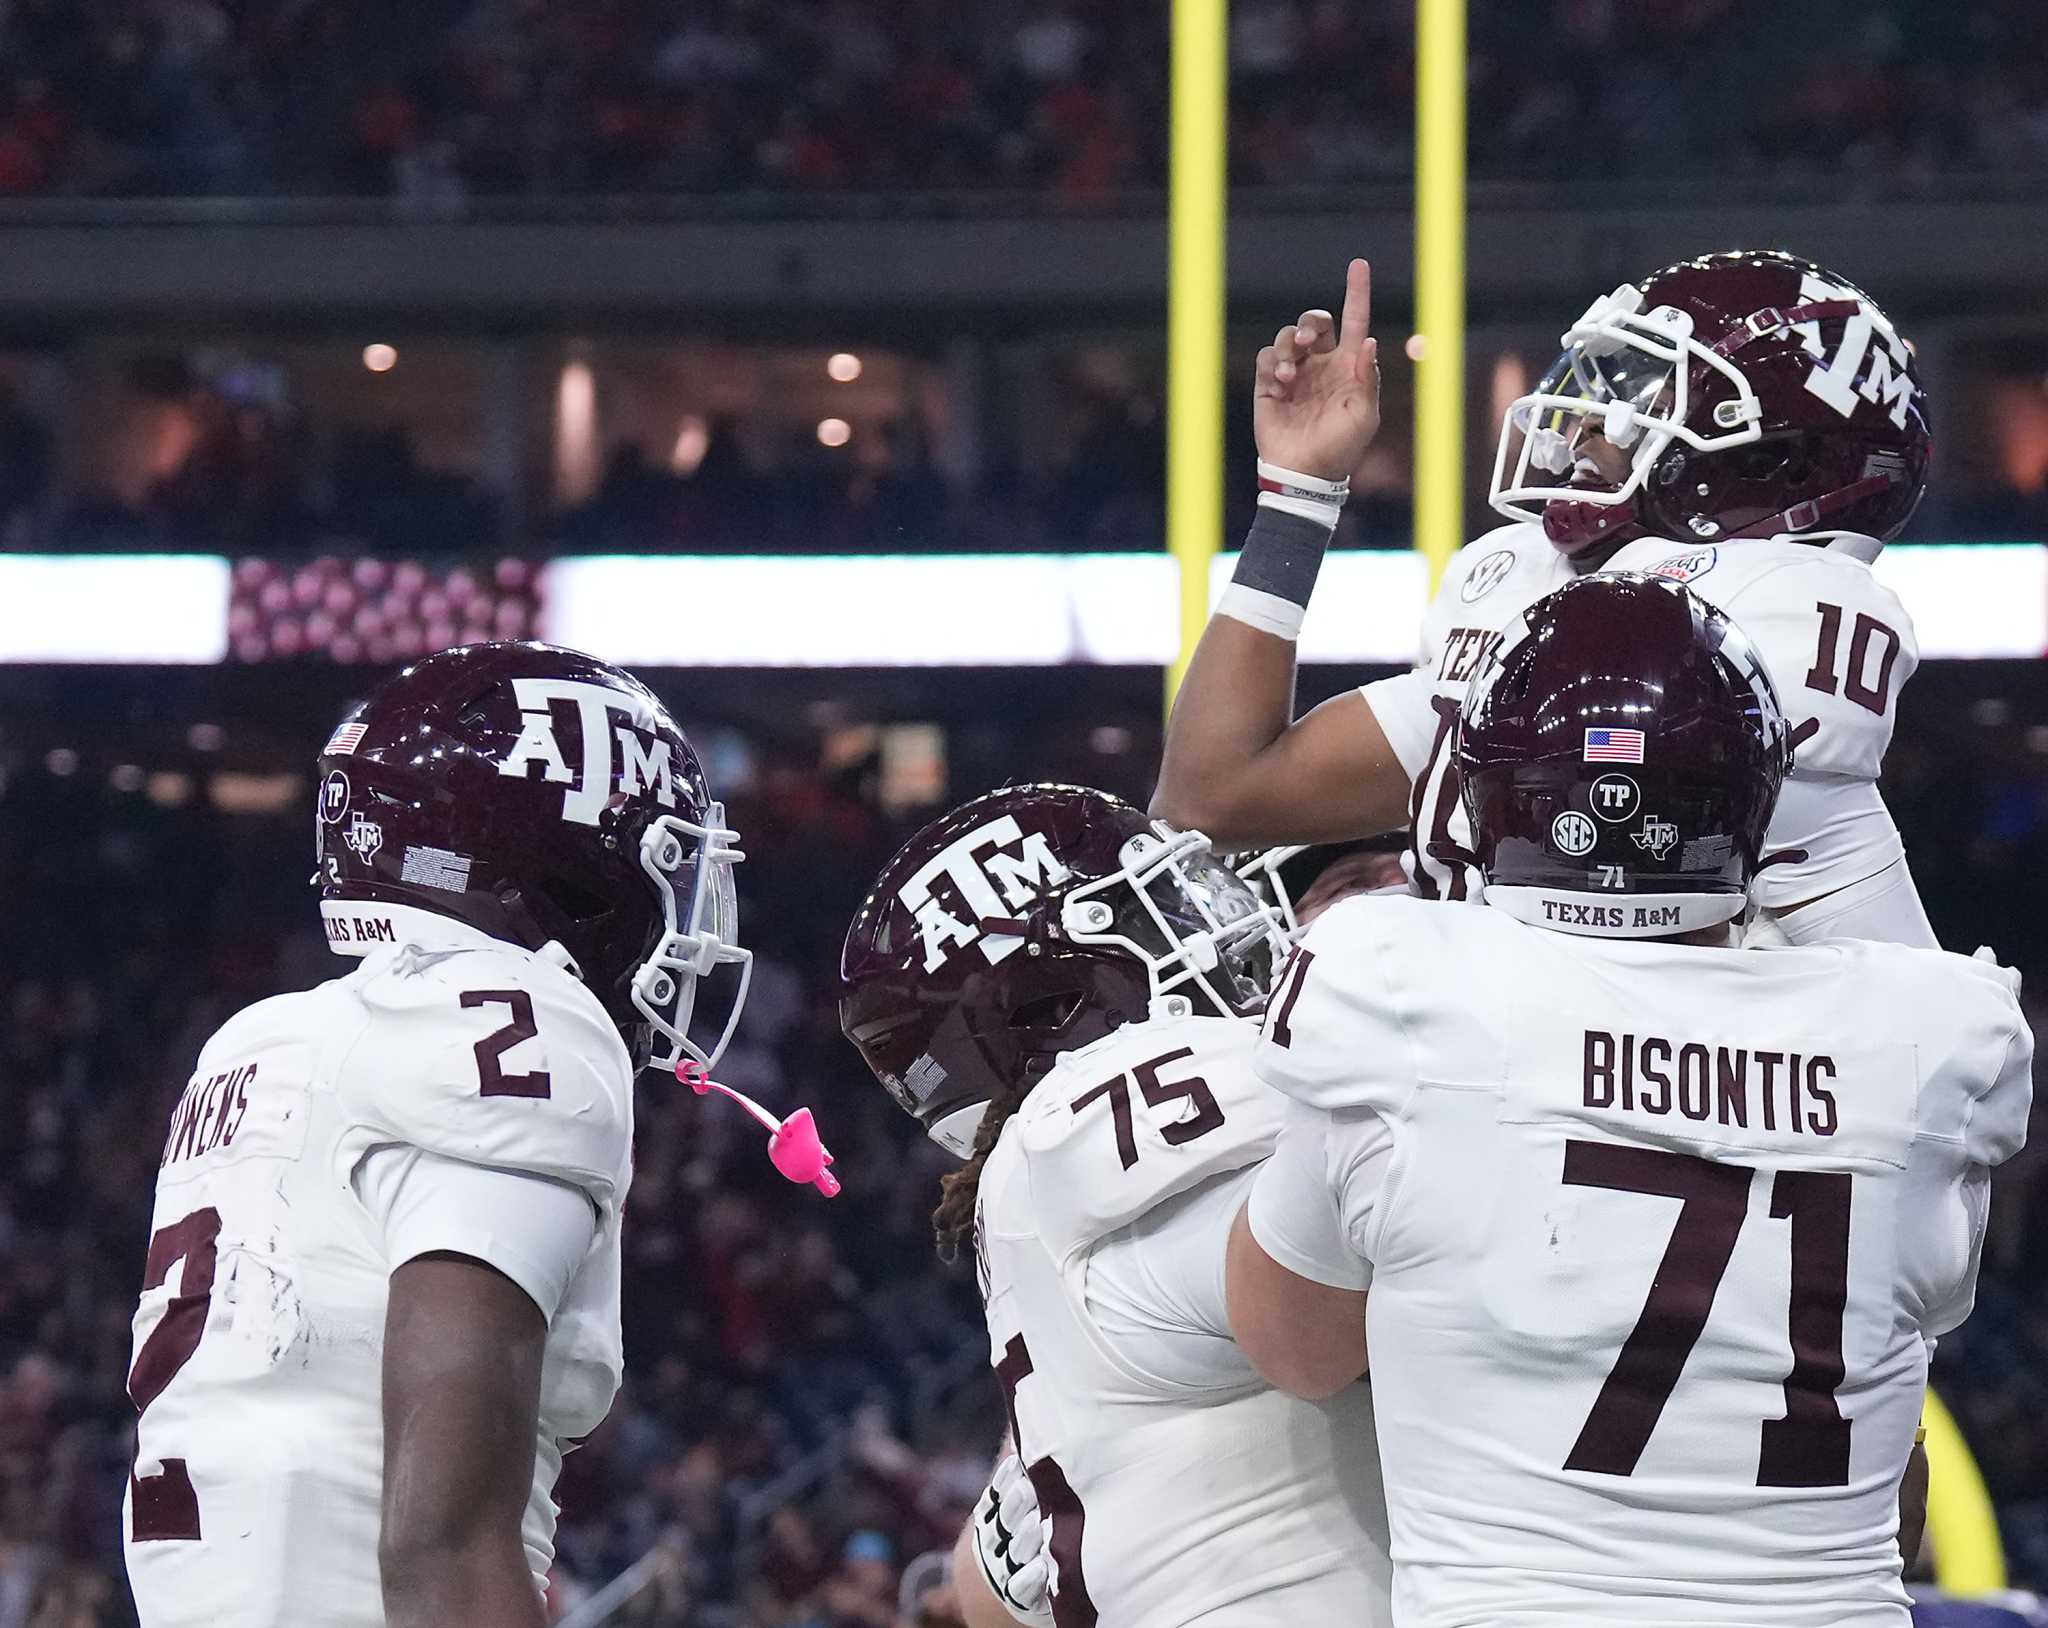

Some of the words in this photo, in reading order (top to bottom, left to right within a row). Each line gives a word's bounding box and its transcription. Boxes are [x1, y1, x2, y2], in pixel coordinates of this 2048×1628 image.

[1437, 628, 1500, 682] TEX
[1804, 601, 1900, 716] 10
[328, 782, 344, 807] TP
[1599, 784, 1631, 808] TP
[1557, 816, 1592, 851] SEC
[1597, 865, 1625, 888] 71
[325, 918, 351, 942] XAS
[352, 918, 397, 942] A&M
[1542, 900, 1624, 927] TEXAS
[1632, 906, 1681, 928] A&M
[459, 989, 551, 1099] 2
[1583, 1030, 1839, 1136] BISONTIS
[1070, 1047, 1225, 1171] 75
[1561, 1139, 1853, 1487] 71
